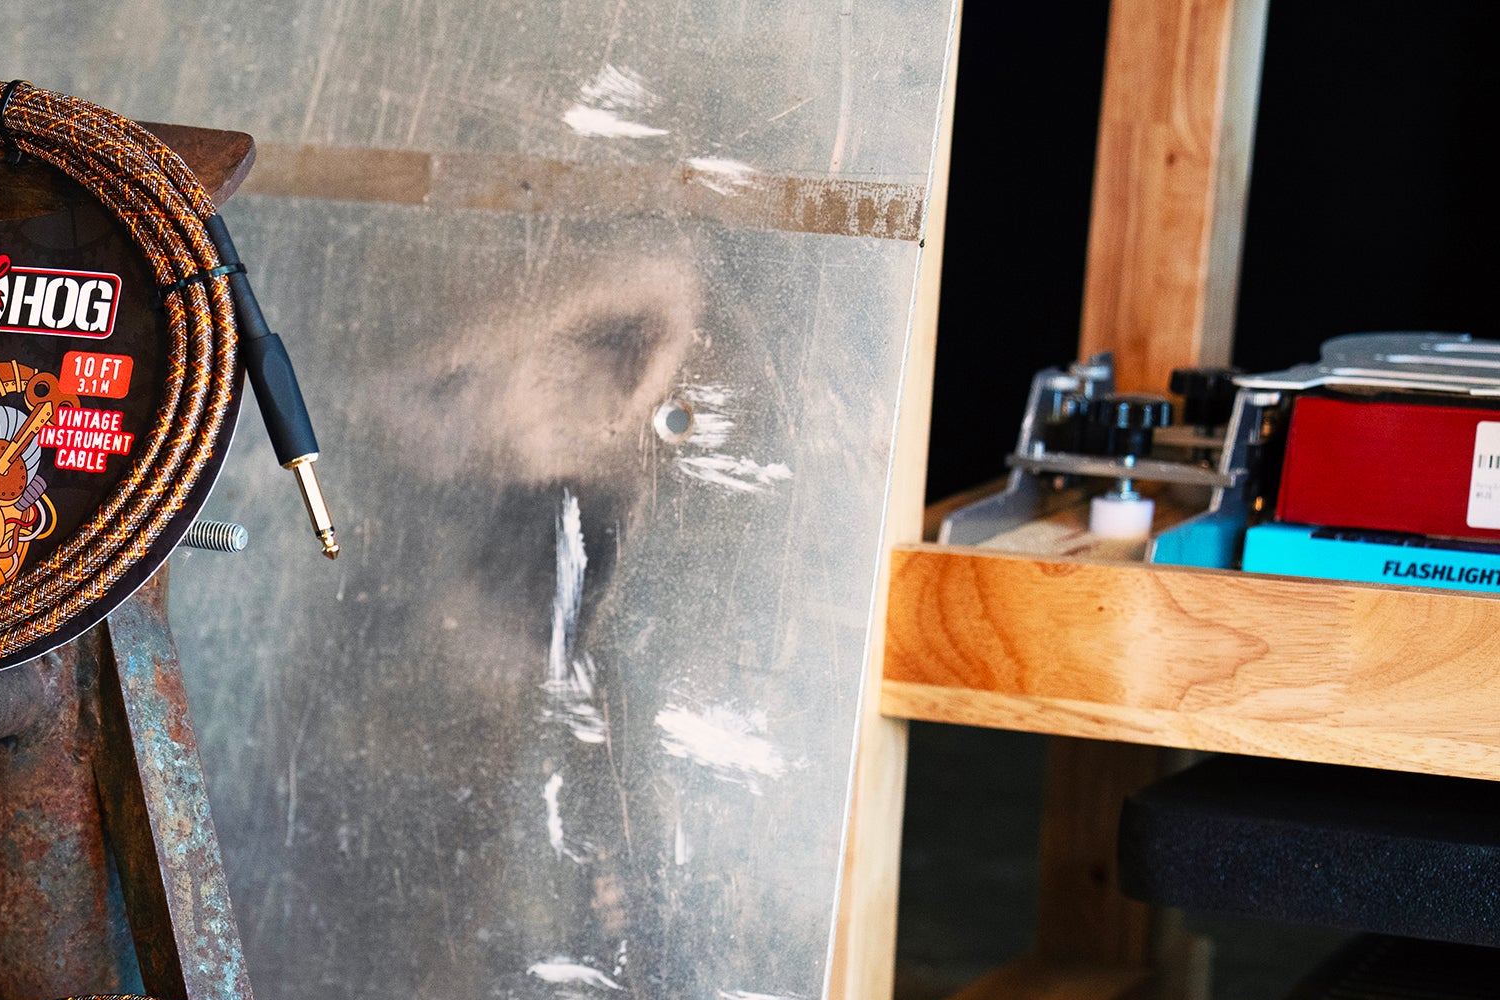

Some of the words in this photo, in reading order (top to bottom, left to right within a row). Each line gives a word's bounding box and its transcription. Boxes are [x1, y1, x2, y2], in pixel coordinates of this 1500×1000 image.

[7, 274, 115, 332] HOG
[74, 355, 96, 378] 10
[99, 357, 123, 381] FT
[76, 377, 98, 394] 3.1
[100, 379, 111, 394] M
[58, 409, 121, 432] VINTAGE
[39, 427, 132, 453] INSTRUMENT
[56, 448, 106, 471] CABLE
[1382, 560, 1500, 586] FLASHLIGHT
